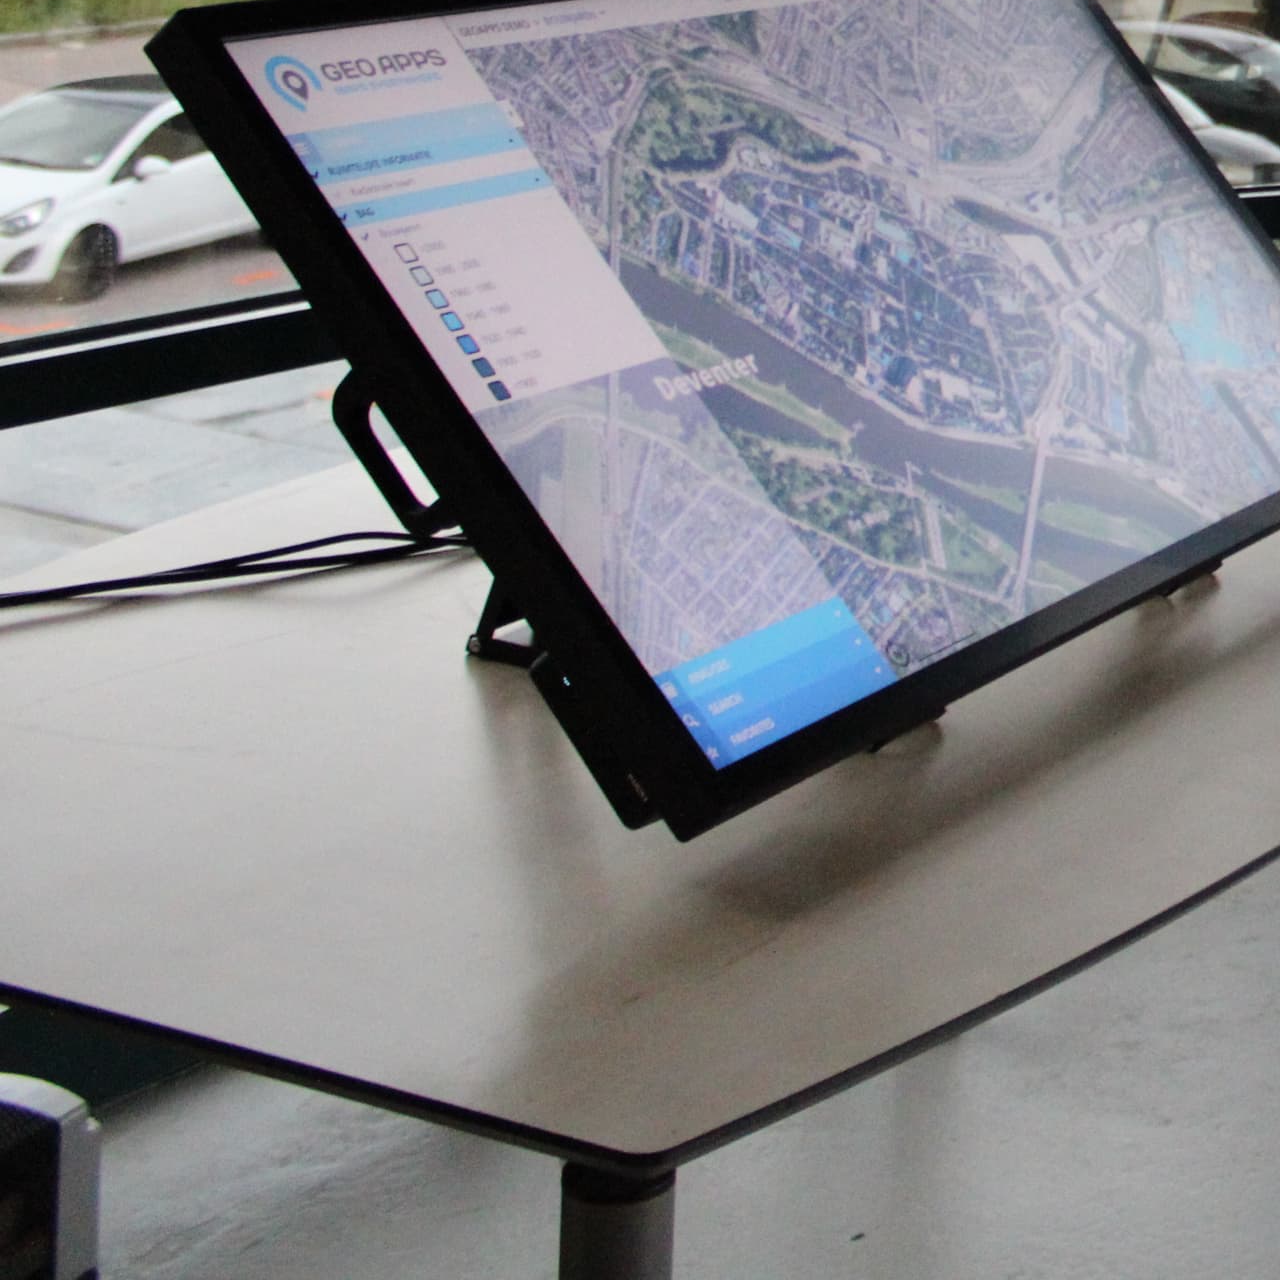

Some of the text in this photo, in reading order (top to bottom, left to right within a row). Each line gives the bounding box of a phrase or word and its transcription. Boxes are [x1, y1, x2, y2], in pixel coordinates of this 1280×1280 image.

[320, 49, 448, 82] GEO APPS
[654, 350, 761, 401] Deventer
